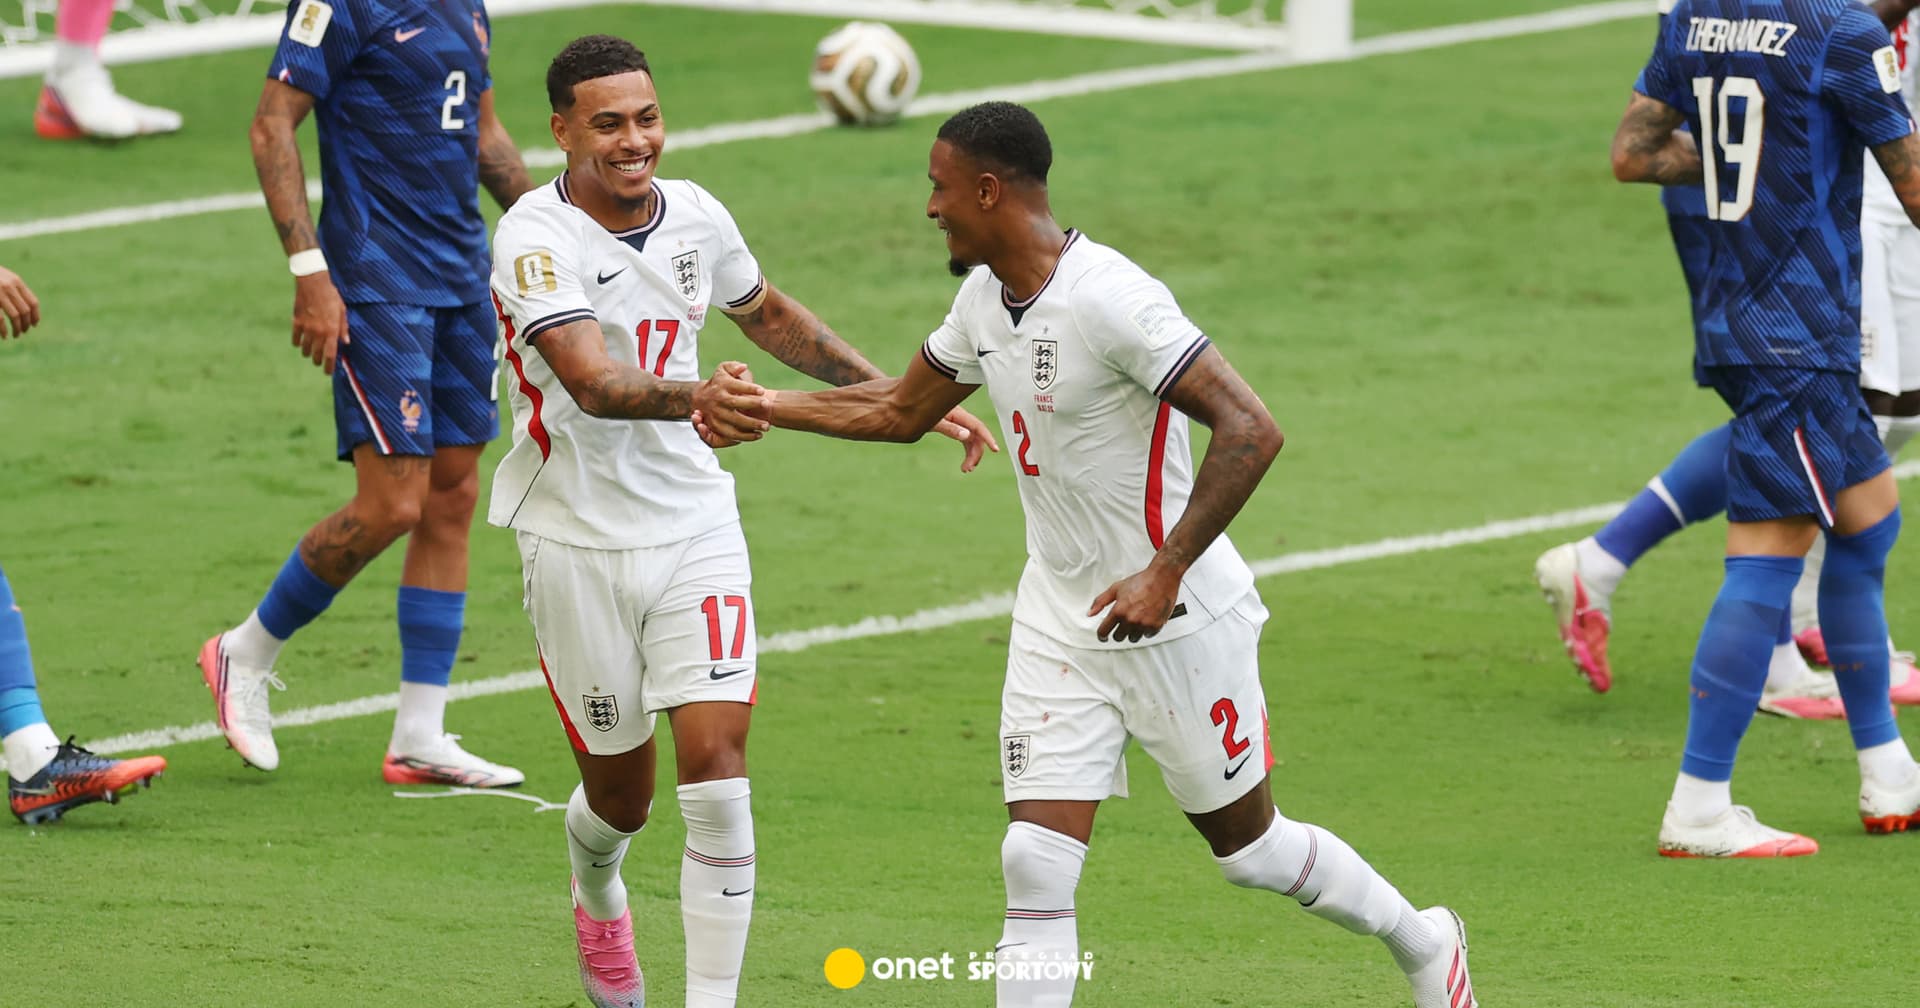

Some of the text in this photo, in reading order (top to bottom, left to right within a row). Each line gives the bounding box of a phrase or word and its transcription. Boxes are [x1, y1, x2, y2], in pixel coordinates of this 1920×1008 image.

[441, 70, 466, 130] 2
[1692, 76, 1764, 222] 19
[636, 319, 680, 378] 17
[1012, 410, 1040, 476] 2
[701, 595, 746, 661] 17
[1209, 697, 1250, 760] 2
